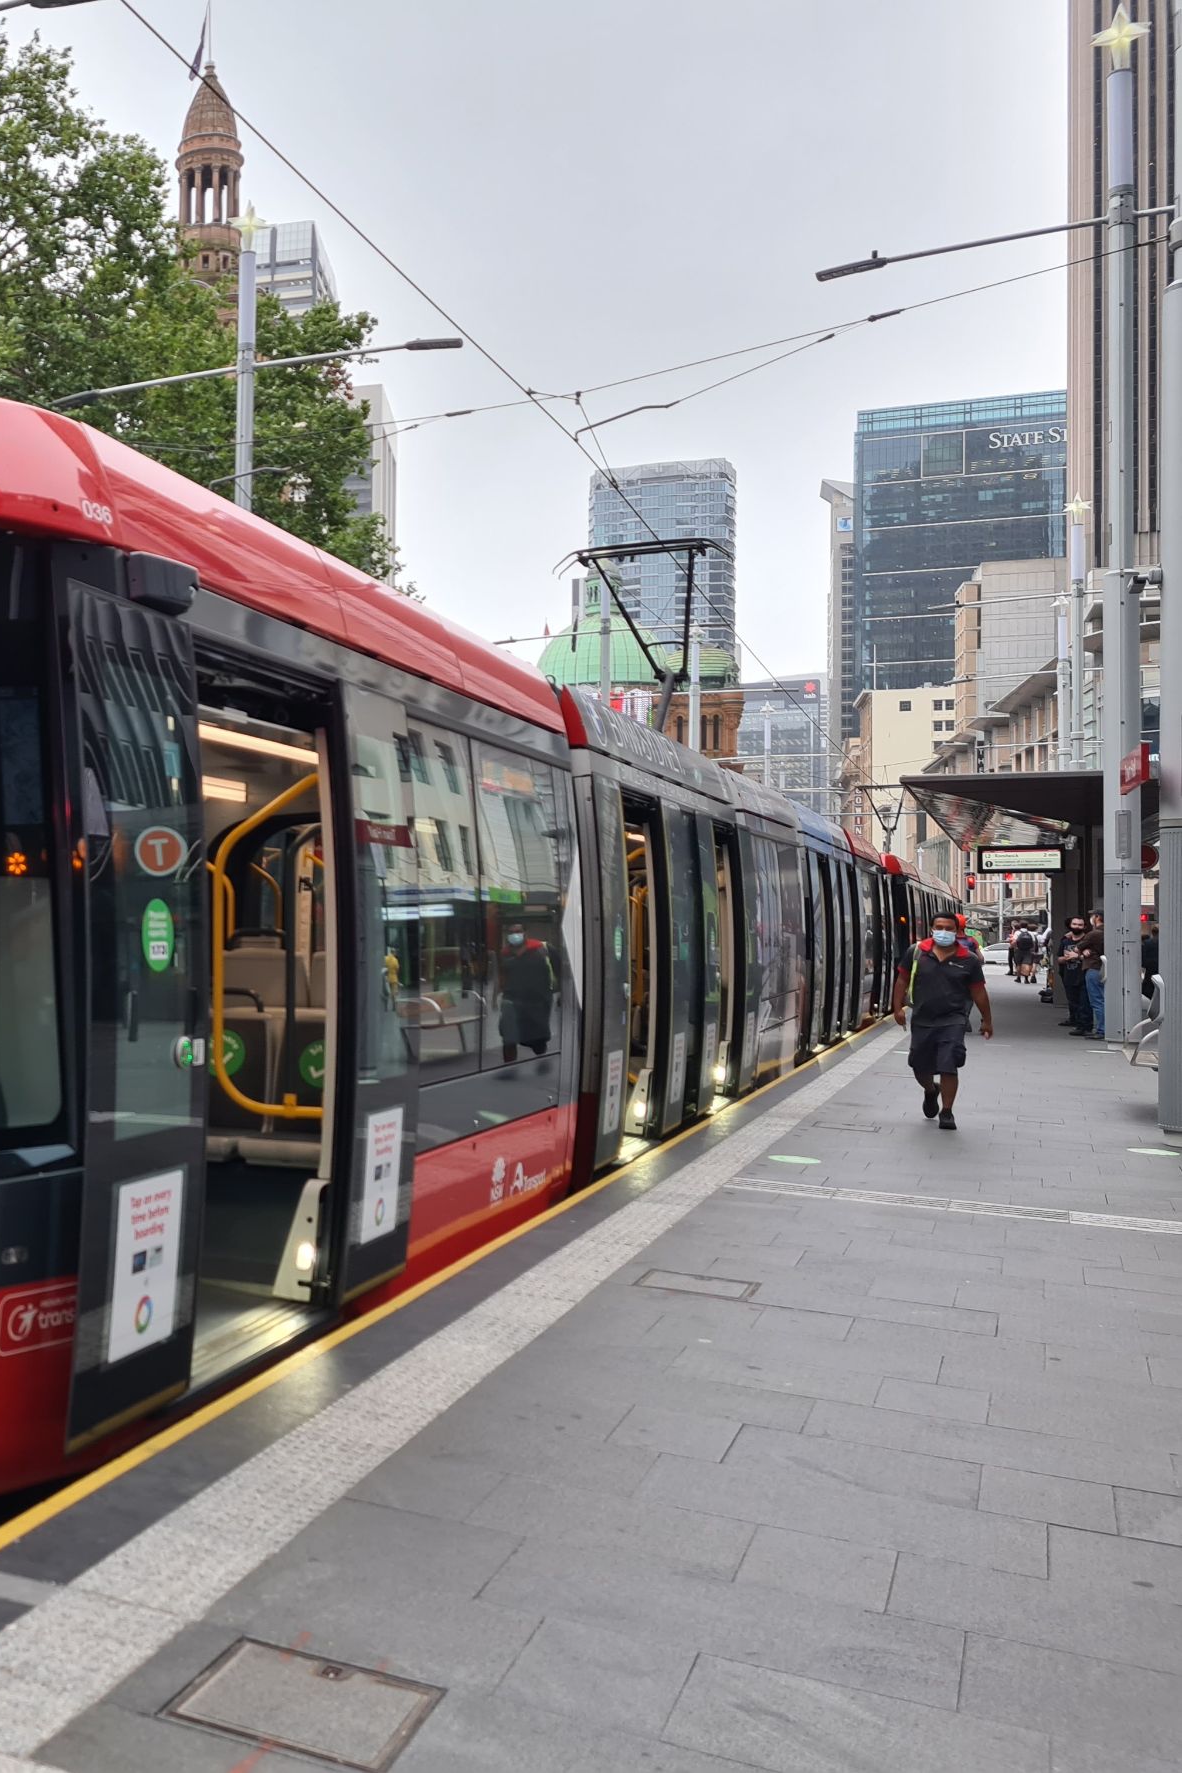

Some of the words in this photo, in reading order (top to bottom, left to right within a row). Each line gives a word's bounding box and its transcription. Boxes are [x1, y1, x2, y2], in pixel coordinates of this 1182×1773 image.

[988, 431, 1045, 449] STATE
[81, 499, 114, 525] 036
[147, 838, 169, 867] T
